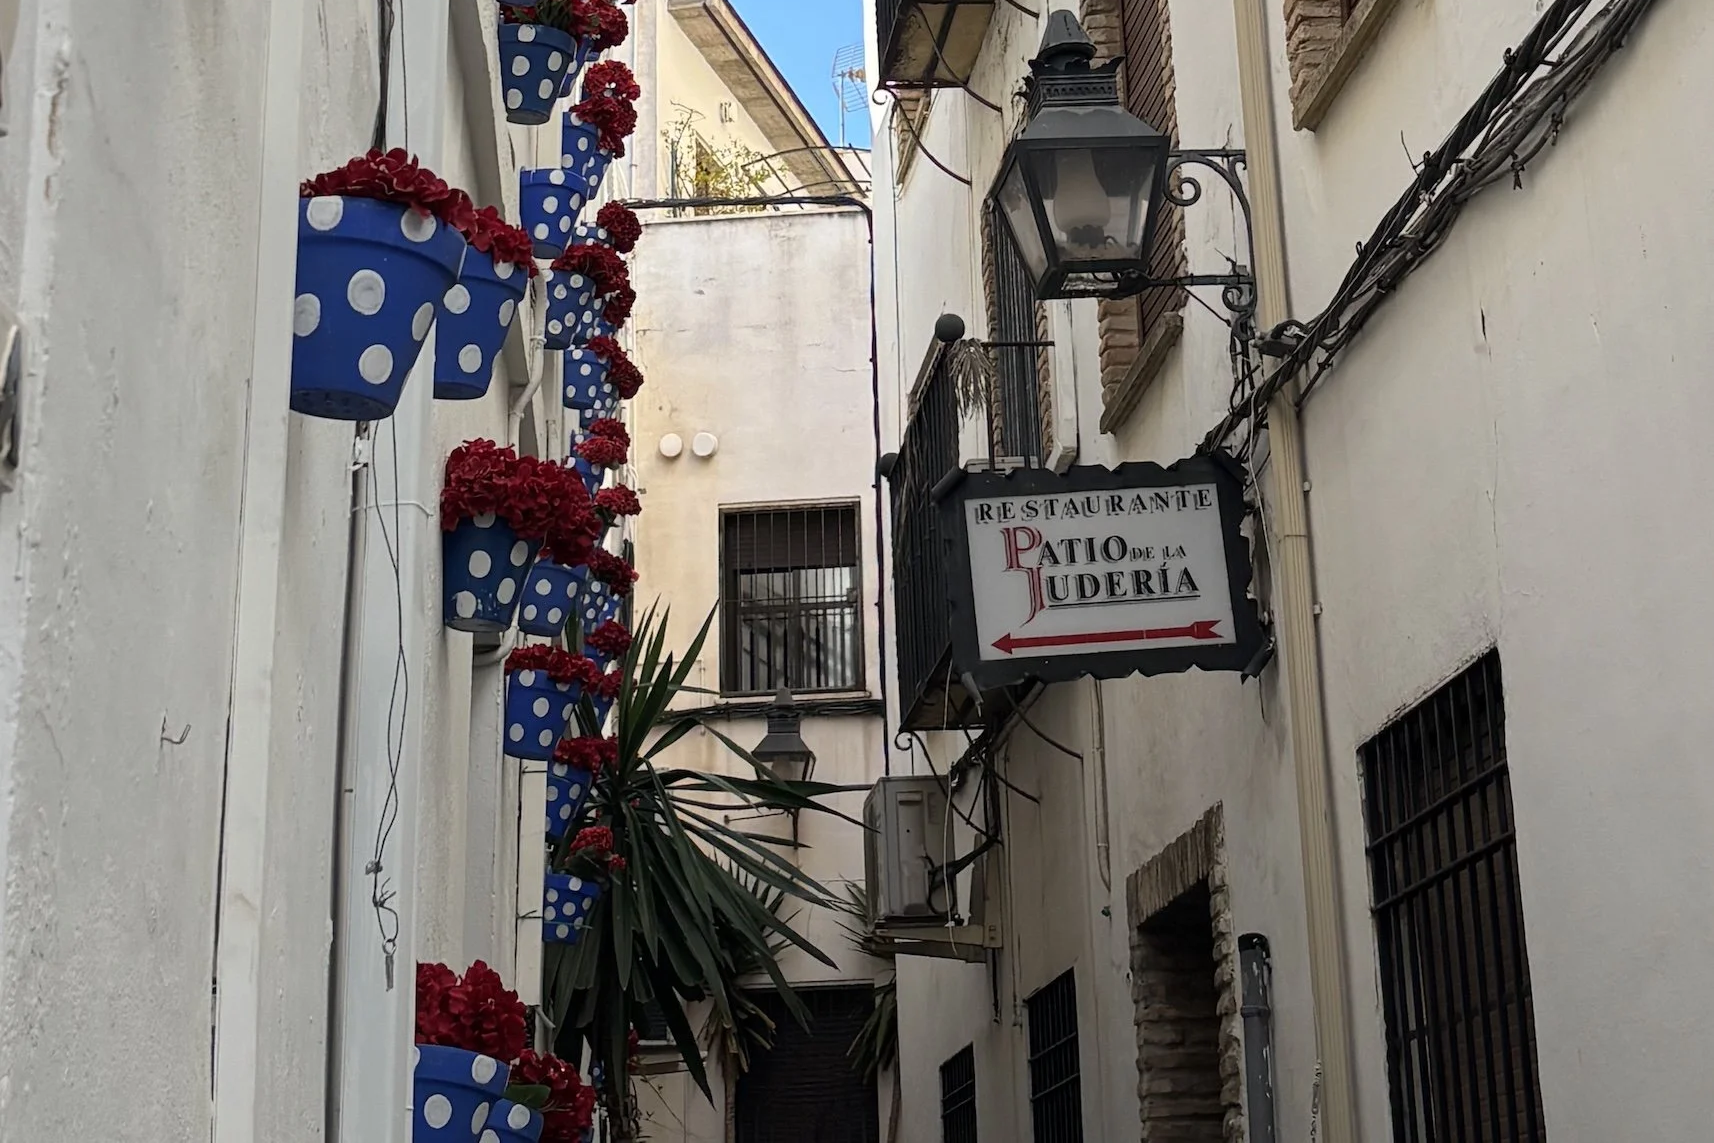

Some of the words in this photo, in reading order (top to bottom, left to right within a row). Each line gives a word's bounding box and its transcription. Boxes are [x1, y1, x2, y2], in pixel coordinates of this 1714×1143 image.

[975, 488, 1213, 525] RESTAURANTE
[1000, 526, 1128, 571] PATIO
[1129, 547, 1155, 562] DE
[1162, 545, 1187, 560] LA
[1014, 562, 1199, 628] JUDERÍA
